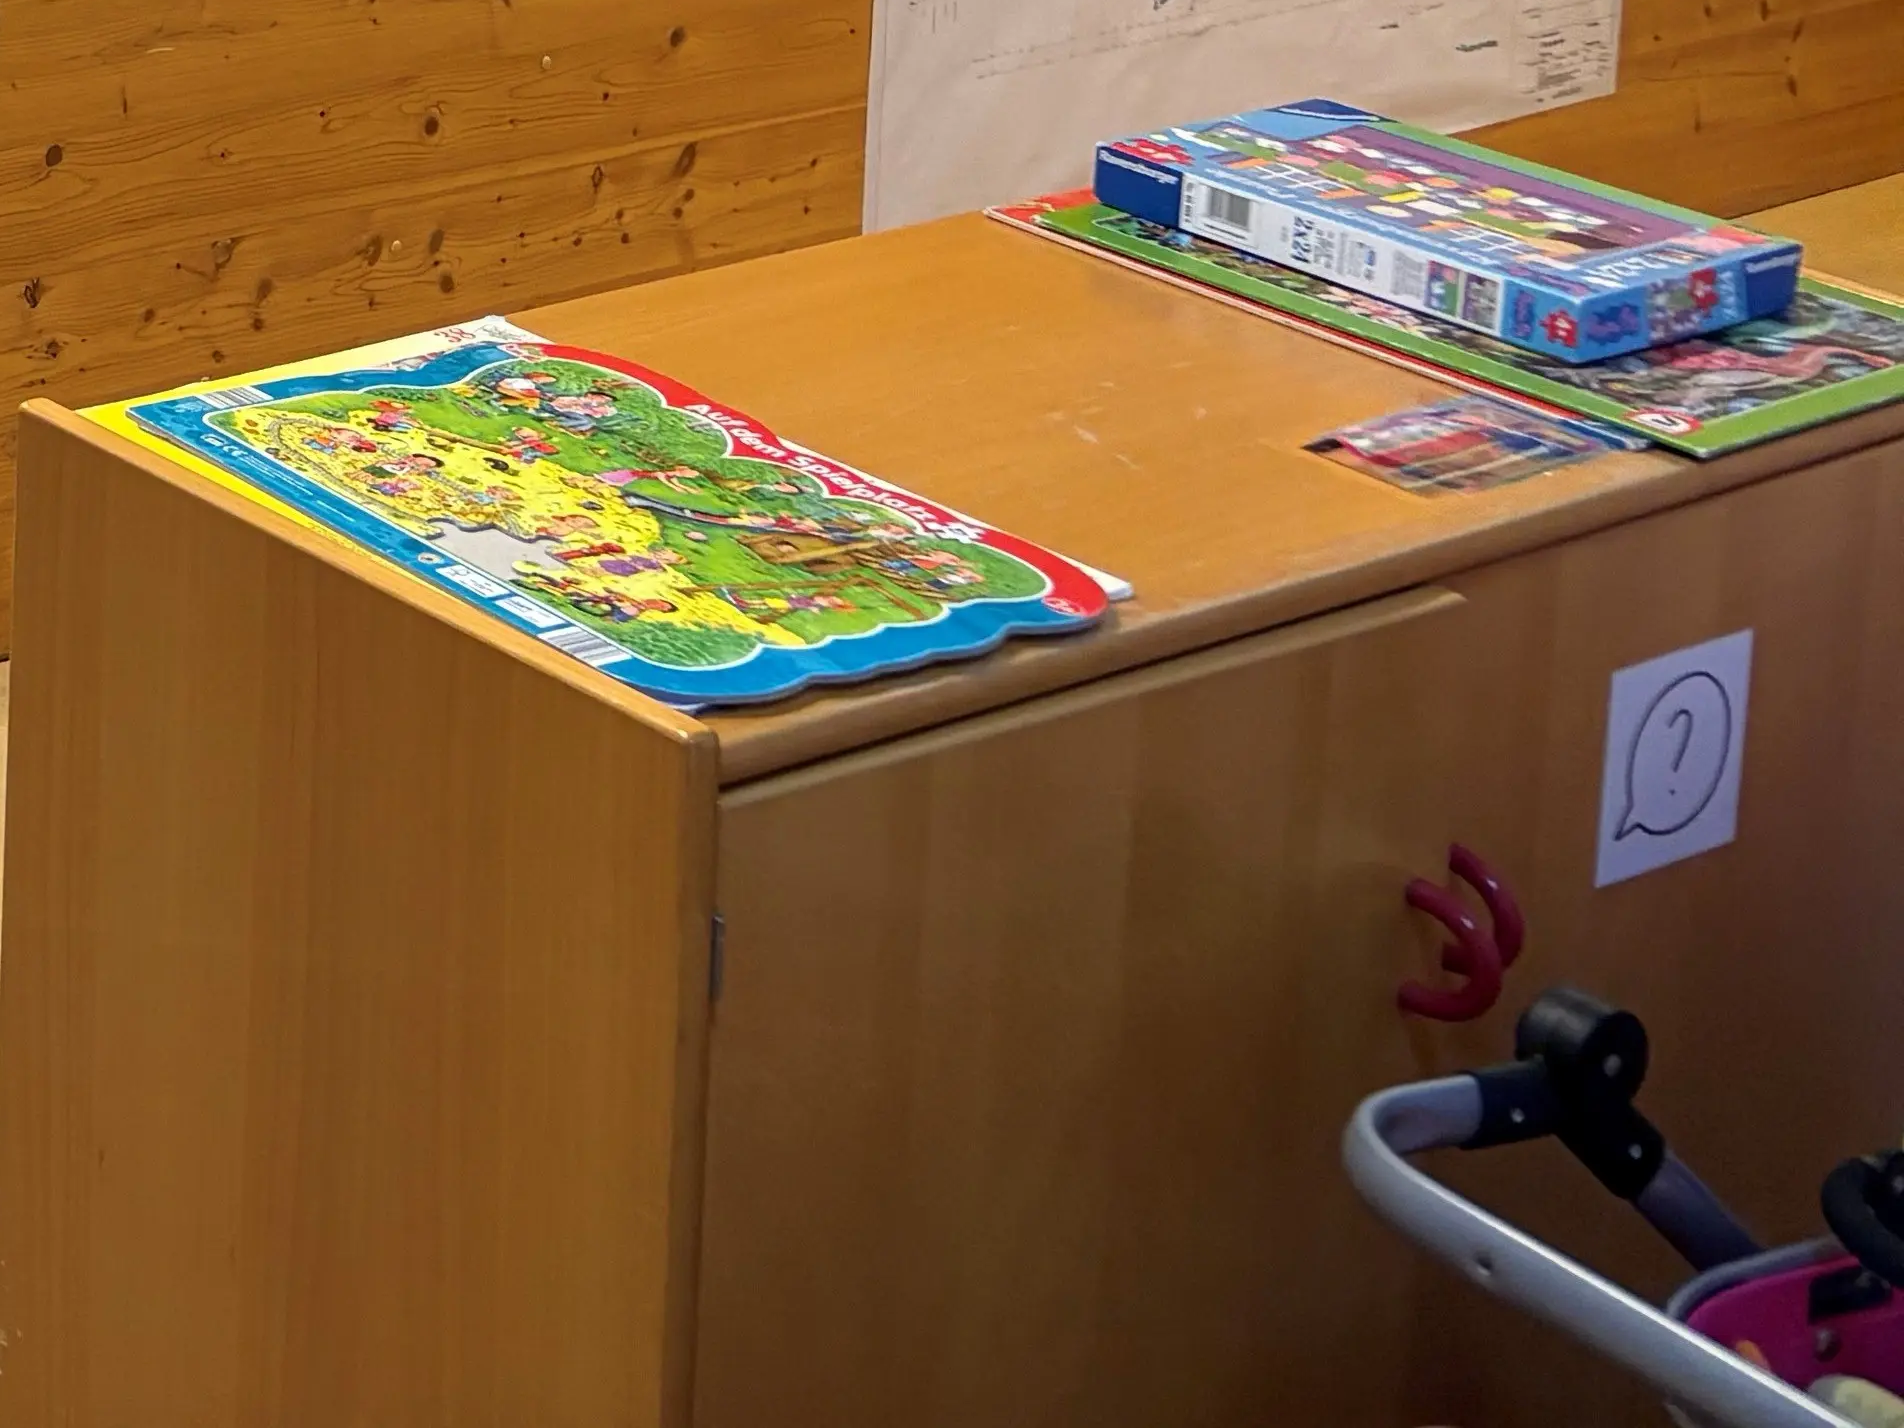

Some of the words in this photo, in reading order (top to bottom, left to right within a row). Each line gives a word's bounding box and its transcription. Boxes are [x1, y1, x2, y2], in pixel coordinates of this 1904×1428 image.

[434, 328, 477, 343] 38
[685, 403, 749, 429] Auf
[731, 427, 787, 459] dem
[789, 455, 940, 524] Spielplatz
